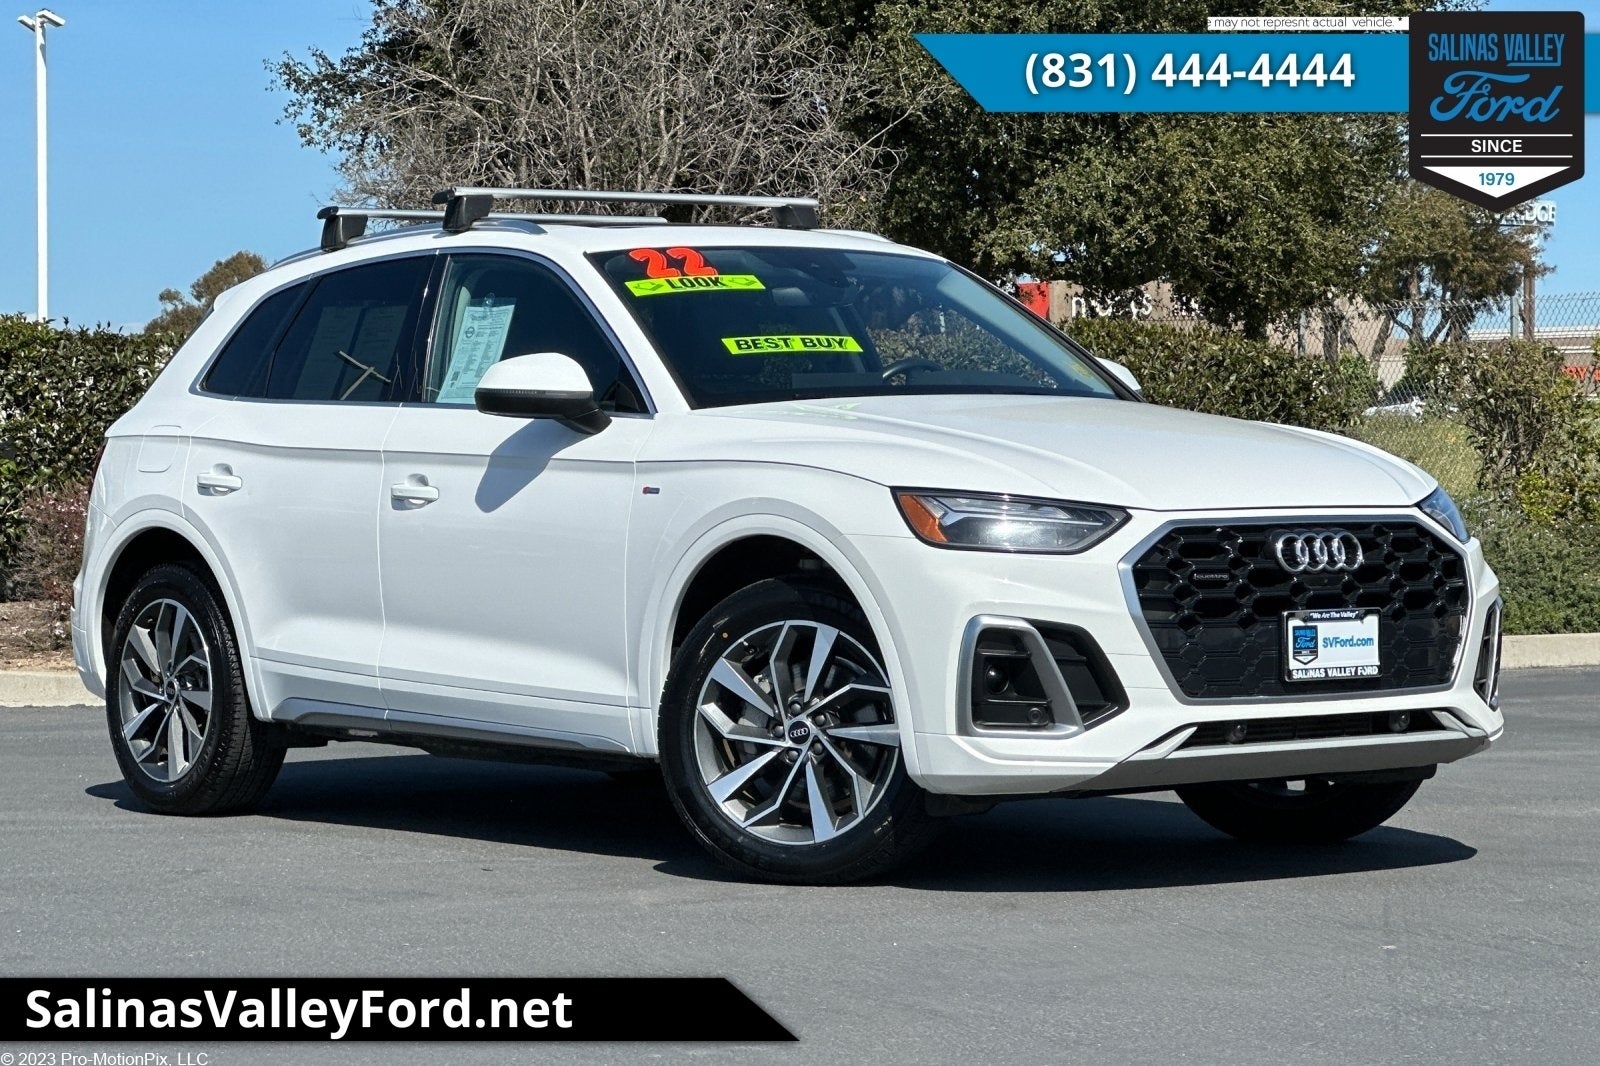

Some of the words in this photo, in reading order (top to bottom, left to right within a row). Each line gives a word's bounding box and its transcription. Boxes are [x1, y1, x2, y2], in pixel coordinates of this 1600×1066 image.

[628, 247, 718, 279] 22
[665, 276, 725, 290] LOOK
[735, 337, 795, 352] BEST
[803, 337, 848, 351] BUY
[1322, 635, 1375, 648] SVFord.com
[1292, 669, 1325, 679] SALINAS
[1326, 666, 1356, 677] VALLEY
[1358, 665, 1379, 676] FORD
